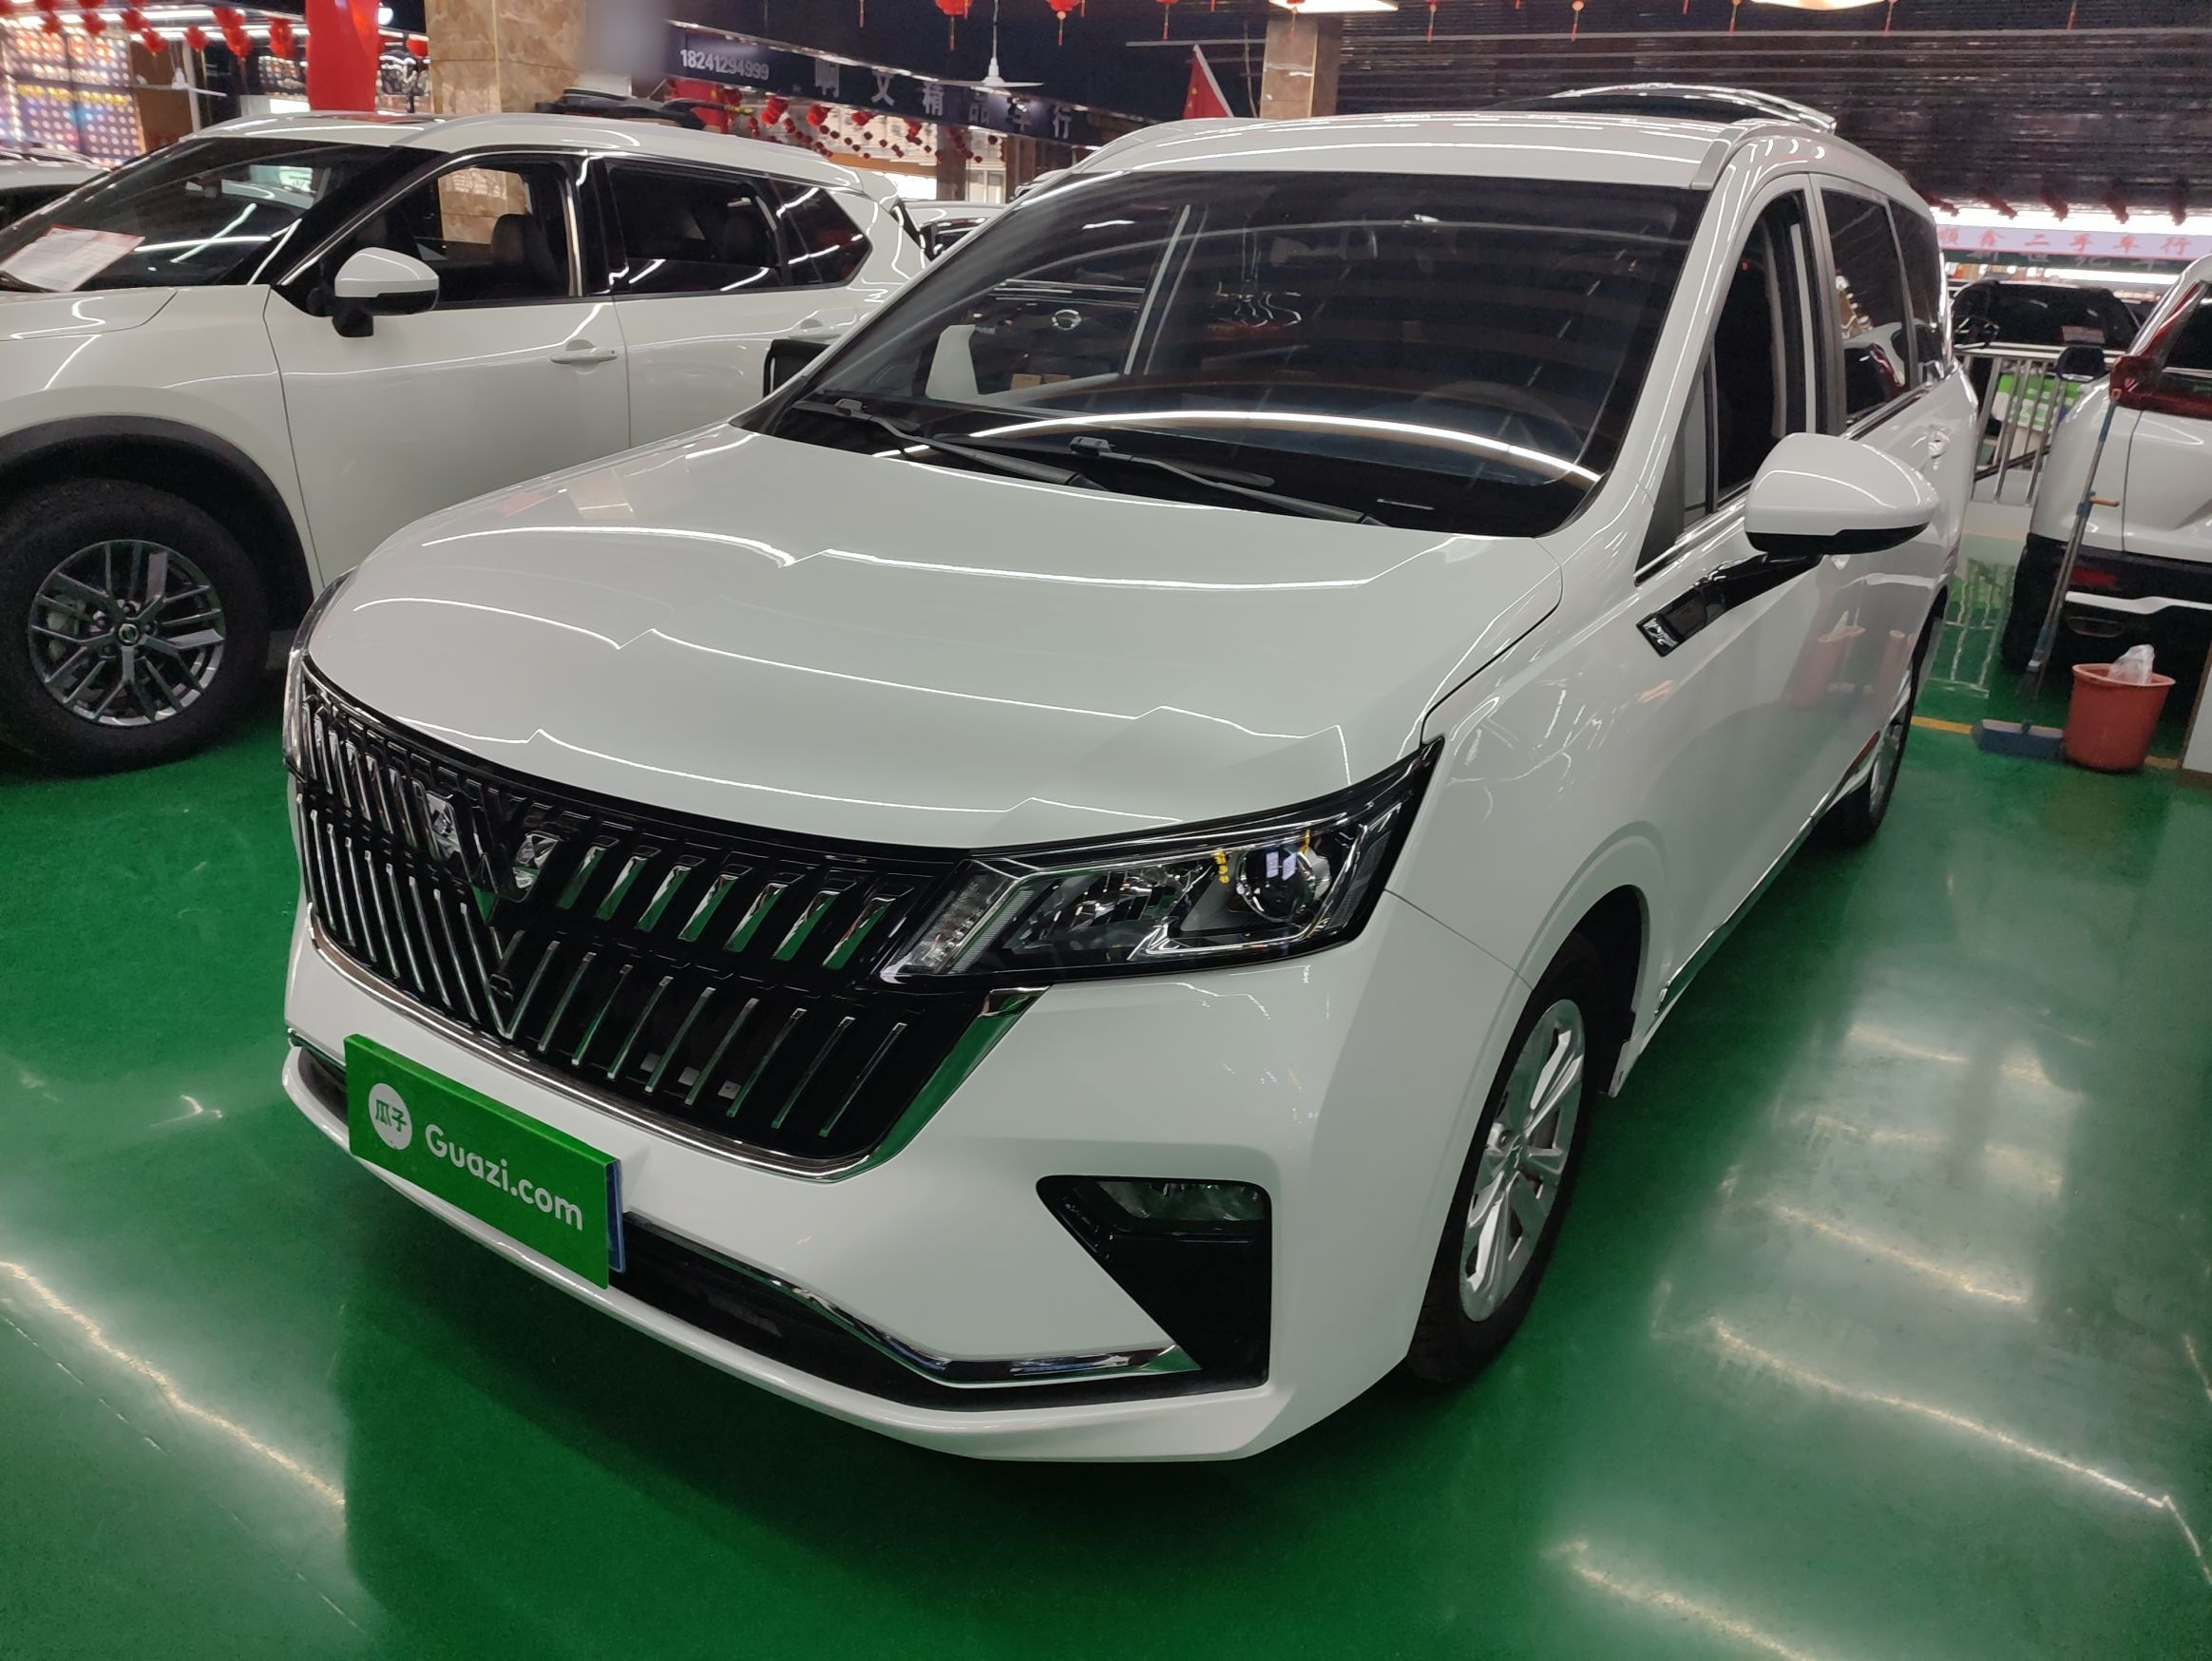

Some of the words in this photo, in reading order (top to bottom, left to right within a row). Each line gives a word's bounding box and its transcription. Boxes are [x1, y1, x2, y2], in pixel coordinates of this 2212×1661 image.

[680, 49, 770, 81] 18241294999
[375, 1099, 407, 1132] 瓜子
[425, 1124, 582, 1231] Guazi.com
